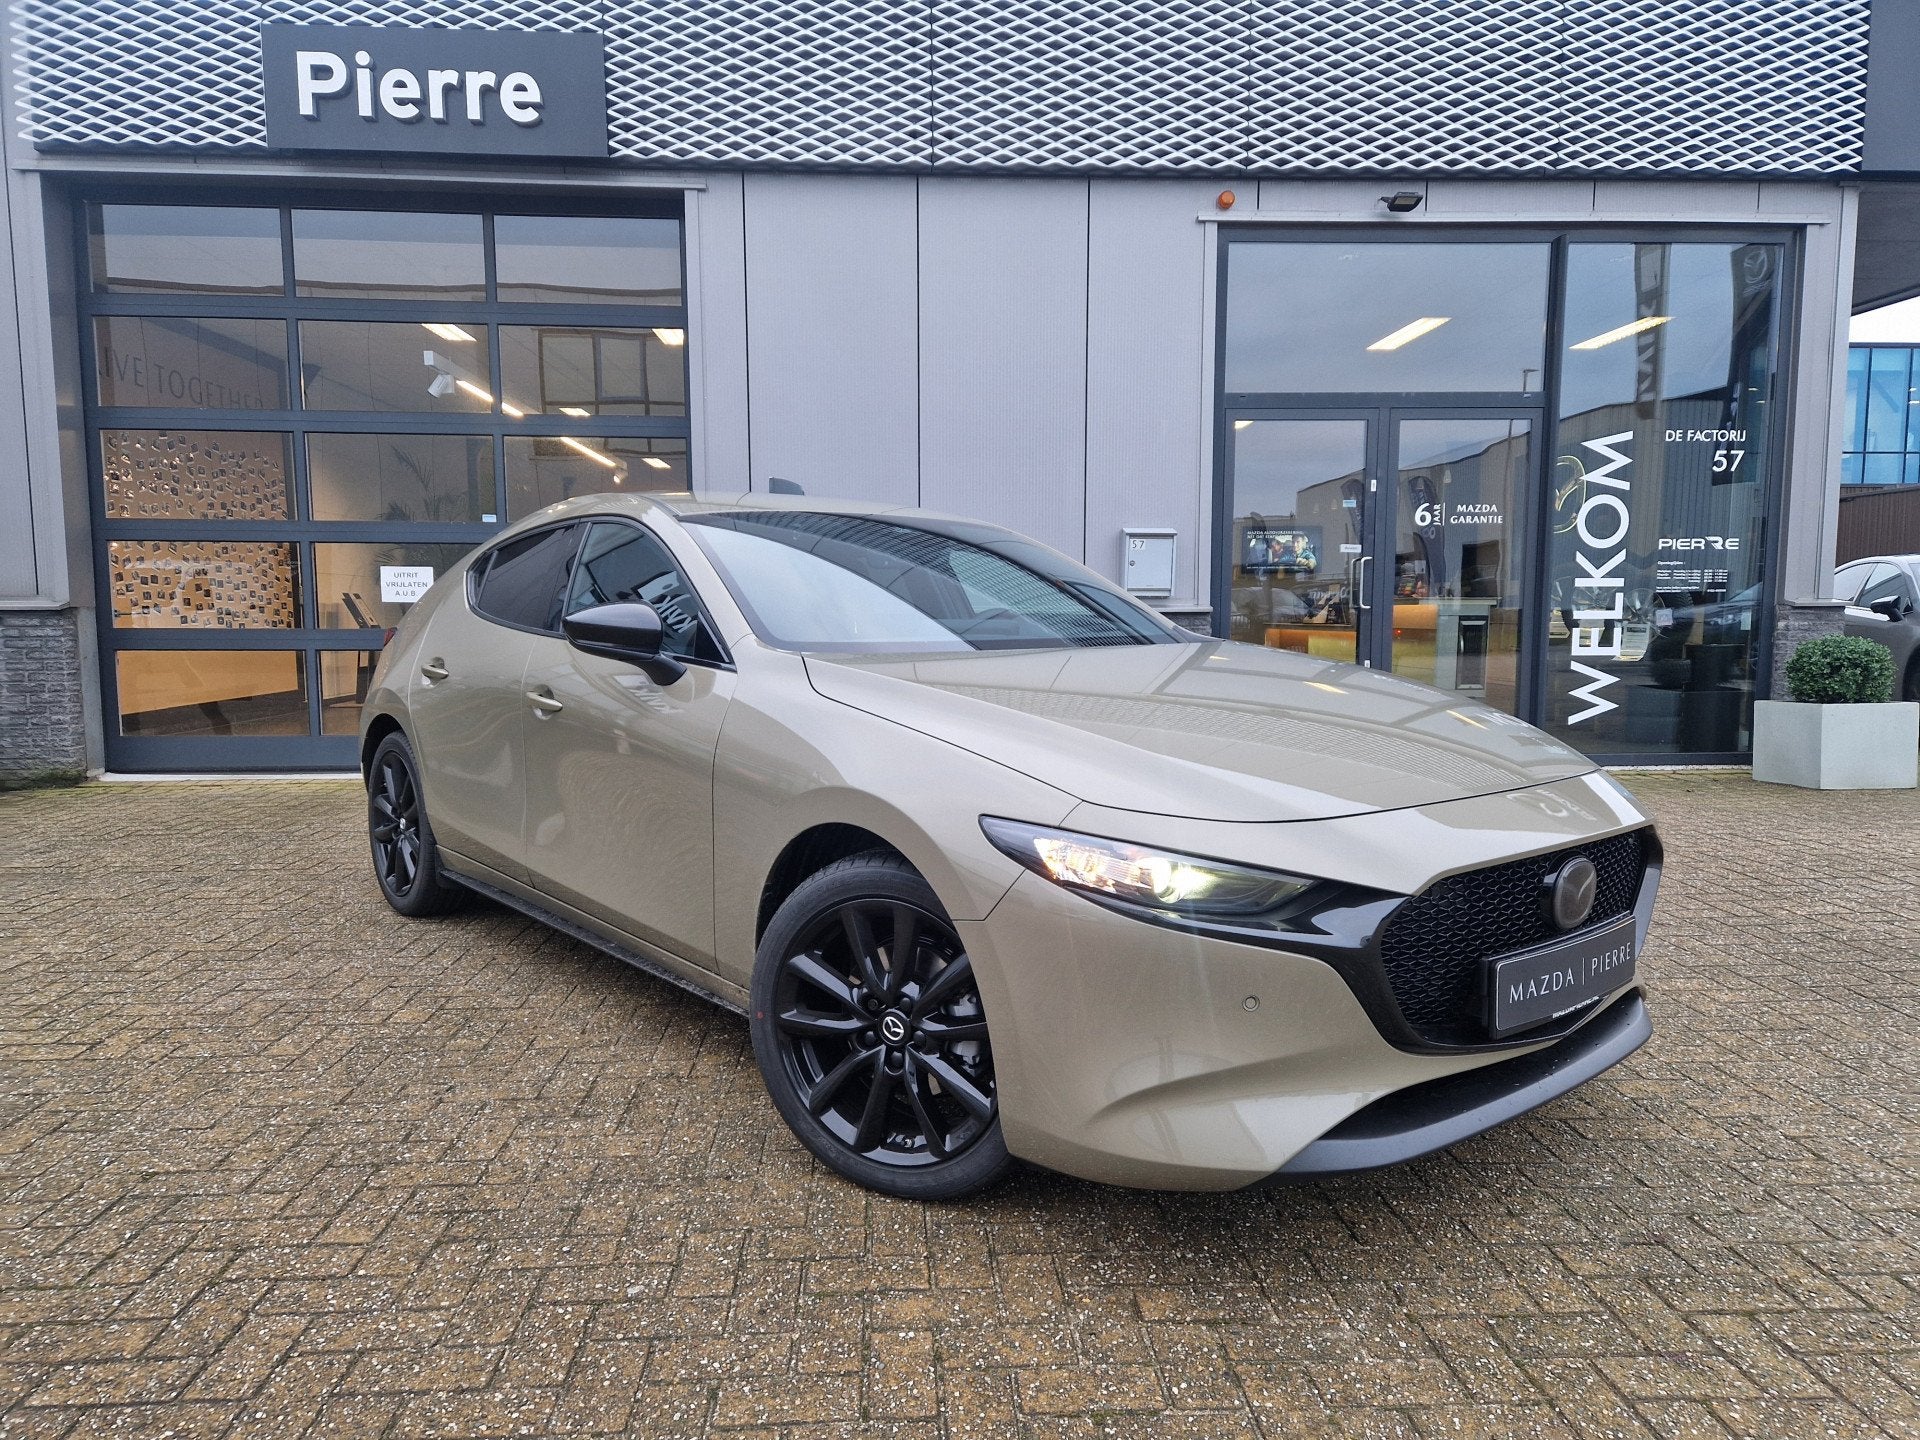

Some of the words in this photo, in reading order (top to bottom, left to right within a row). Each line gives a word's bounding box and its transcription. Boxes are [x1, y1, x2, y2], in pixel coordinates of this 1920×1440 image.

[295, 50, 543, 125] Pierre
[1665, 429, 1683, 442] DE
[1686, 429, 1746, 442] FACTORIJ
[1711, 449, 1746, 473] 57
[1414, 502, 1432, 527] 6
[1433, 503, 1442, 526] JAAR
[1450, 515, 1503, 524] GARANTIE
[1456, 504, 1498, 513] MAZDA
[1132, 539, 1145, 549] 57
[1658, 535, 1740, 550] PIERRE
[1567, 430, 1634, 726] WELKOM
[1509, 967, 1575, 1004] MAZDA
[1591, 942, 1631, 976] PIERRE
